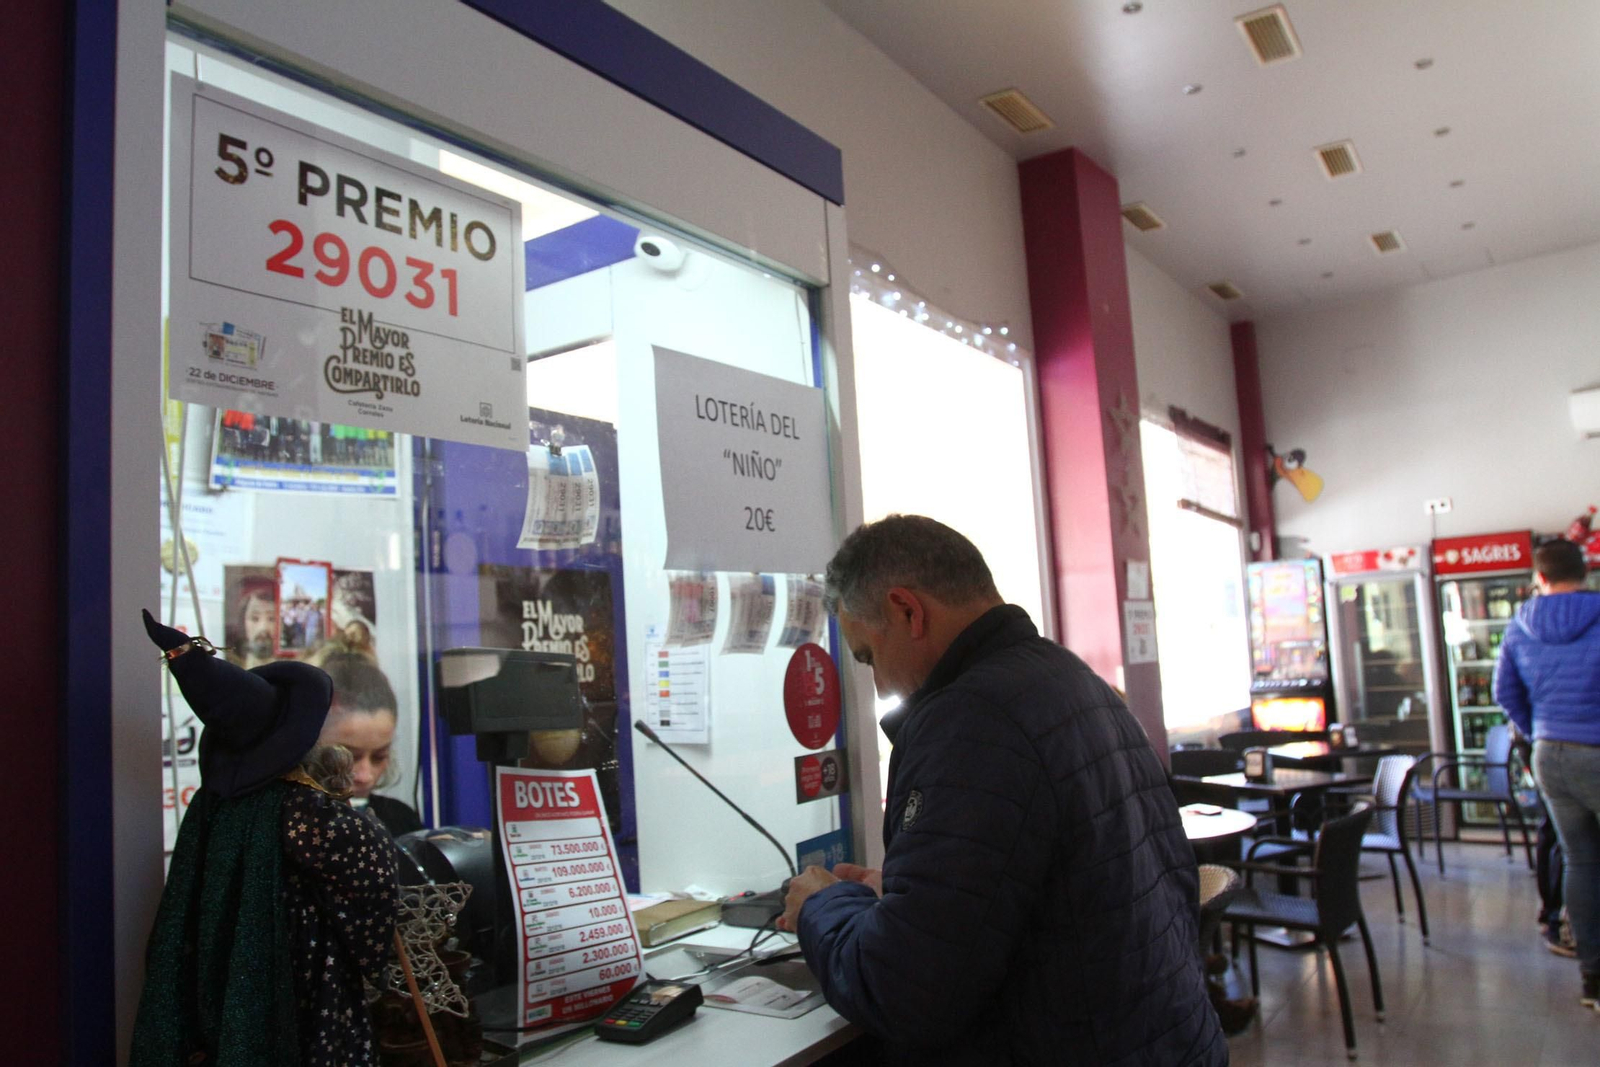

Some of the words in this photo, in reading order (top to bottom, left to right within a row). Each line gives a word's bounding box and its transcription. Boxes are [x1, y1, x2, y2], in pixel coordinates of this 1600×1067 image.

[215, 133, 275, 185] 5º
[298, 160, 497, 262] PREMIO
[266, 219, 459, 316] 29031
[341, 306, 356, 325] EL
[358, 309, 410, 350] MAYOR
[340, 326, 395, 370] PREMIO
[399, 352, 416, 377] ES
[189, 366, 201, 378] 22
[203, 370, 216, 380] de
[218, 372, 275, 391] DICIEMBRE
[324, 355, 421, 400] COMPARTIRLO
[695, 393, 767, 433] LOTERÍA
[770, 412, 801, 440] DEL
[744, 506, 776, 532] 20€
[1461, 543, 1522, 566] SAGRES
[522, 600, 538, 619] EL
[537, 599, 584, 640] MAYOR
[575, 634, 590, 662] ES
[513, 780, 580, 809] BOTES
[550, 841, 599, 856] 73.500.000
[552, 861, 605, 878] 109.000.000
[568, 882, 611, 899] 6.200.000
[589, 904, 618, 919] 10.000
[578, 923, 624, 943] 2.459.000
[582, 942, 629, 964] 2.300.000
[598, 962, 632, 980] 60.000
